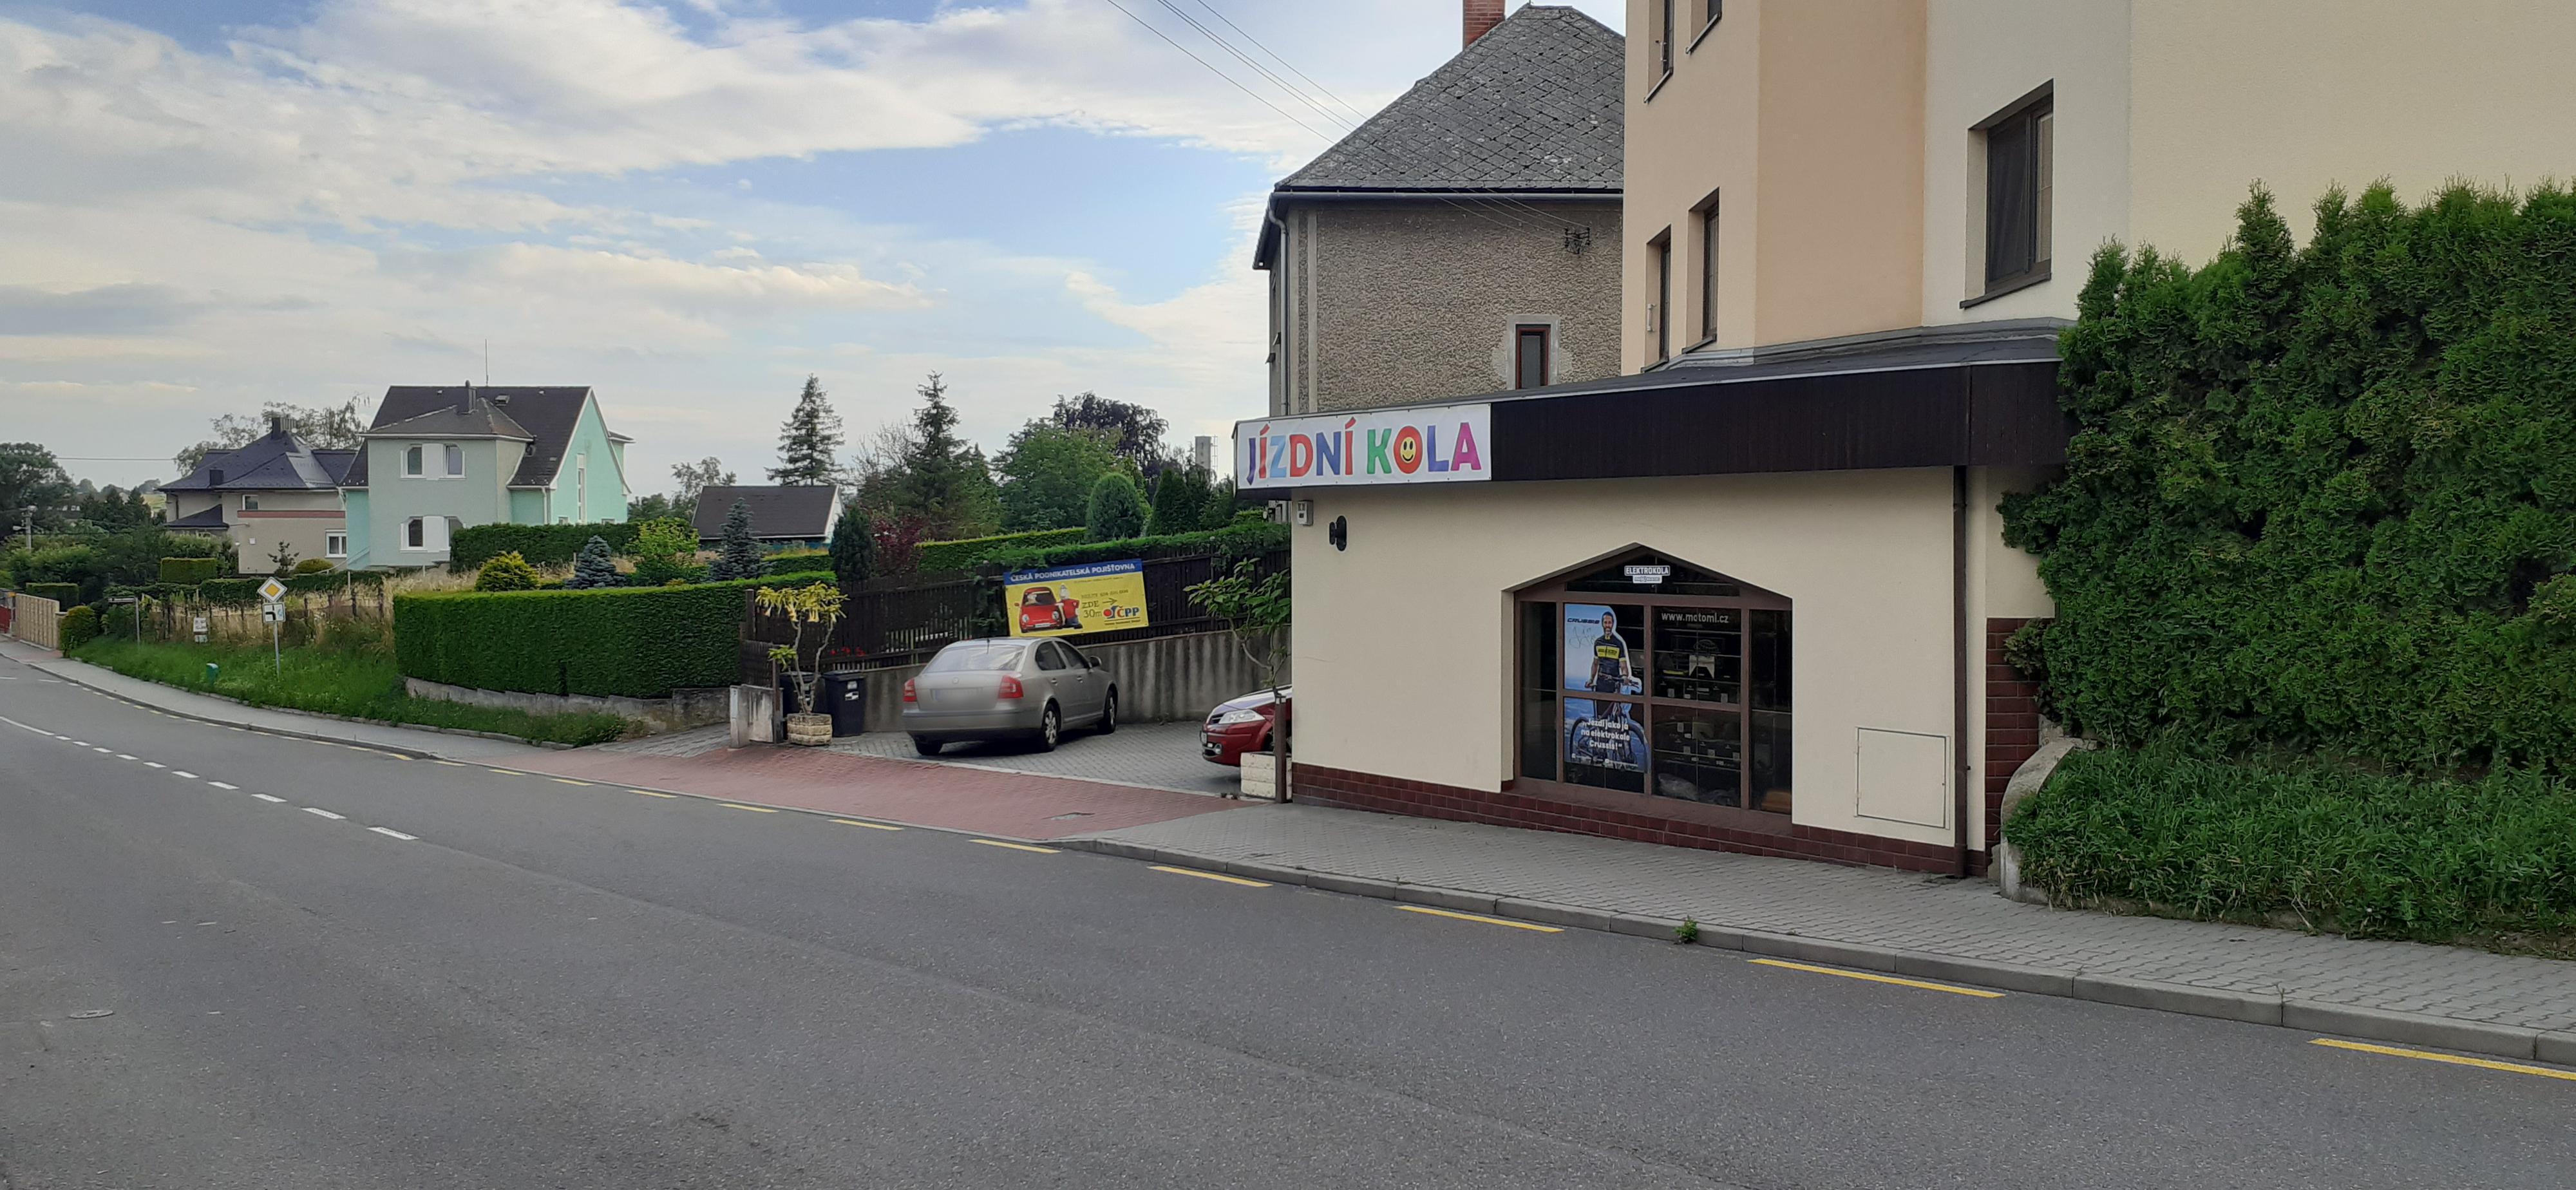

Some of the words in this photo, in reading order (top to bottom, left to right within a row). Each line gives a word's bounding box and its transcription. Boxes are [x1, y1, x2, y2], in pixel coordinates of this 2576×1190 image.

[1246, 417, 1356, 486] JÍZDNÍ
[1367, 422, 1482, 475] KOLA
[1010, 572, 1033, 581] ČESKÁ
[1035, 567, 1090, 579] PODNIKATELSKÁ
[1092, 563, 1135, 573] POJIŠŤOVNA
[1082, 600, 1099, 609] ZDE
[1083, 609, 1102, 618] 30m
[1117, 605, 1140, 618] ČPP
[1591, 730, 1631, 741] elektrokole
